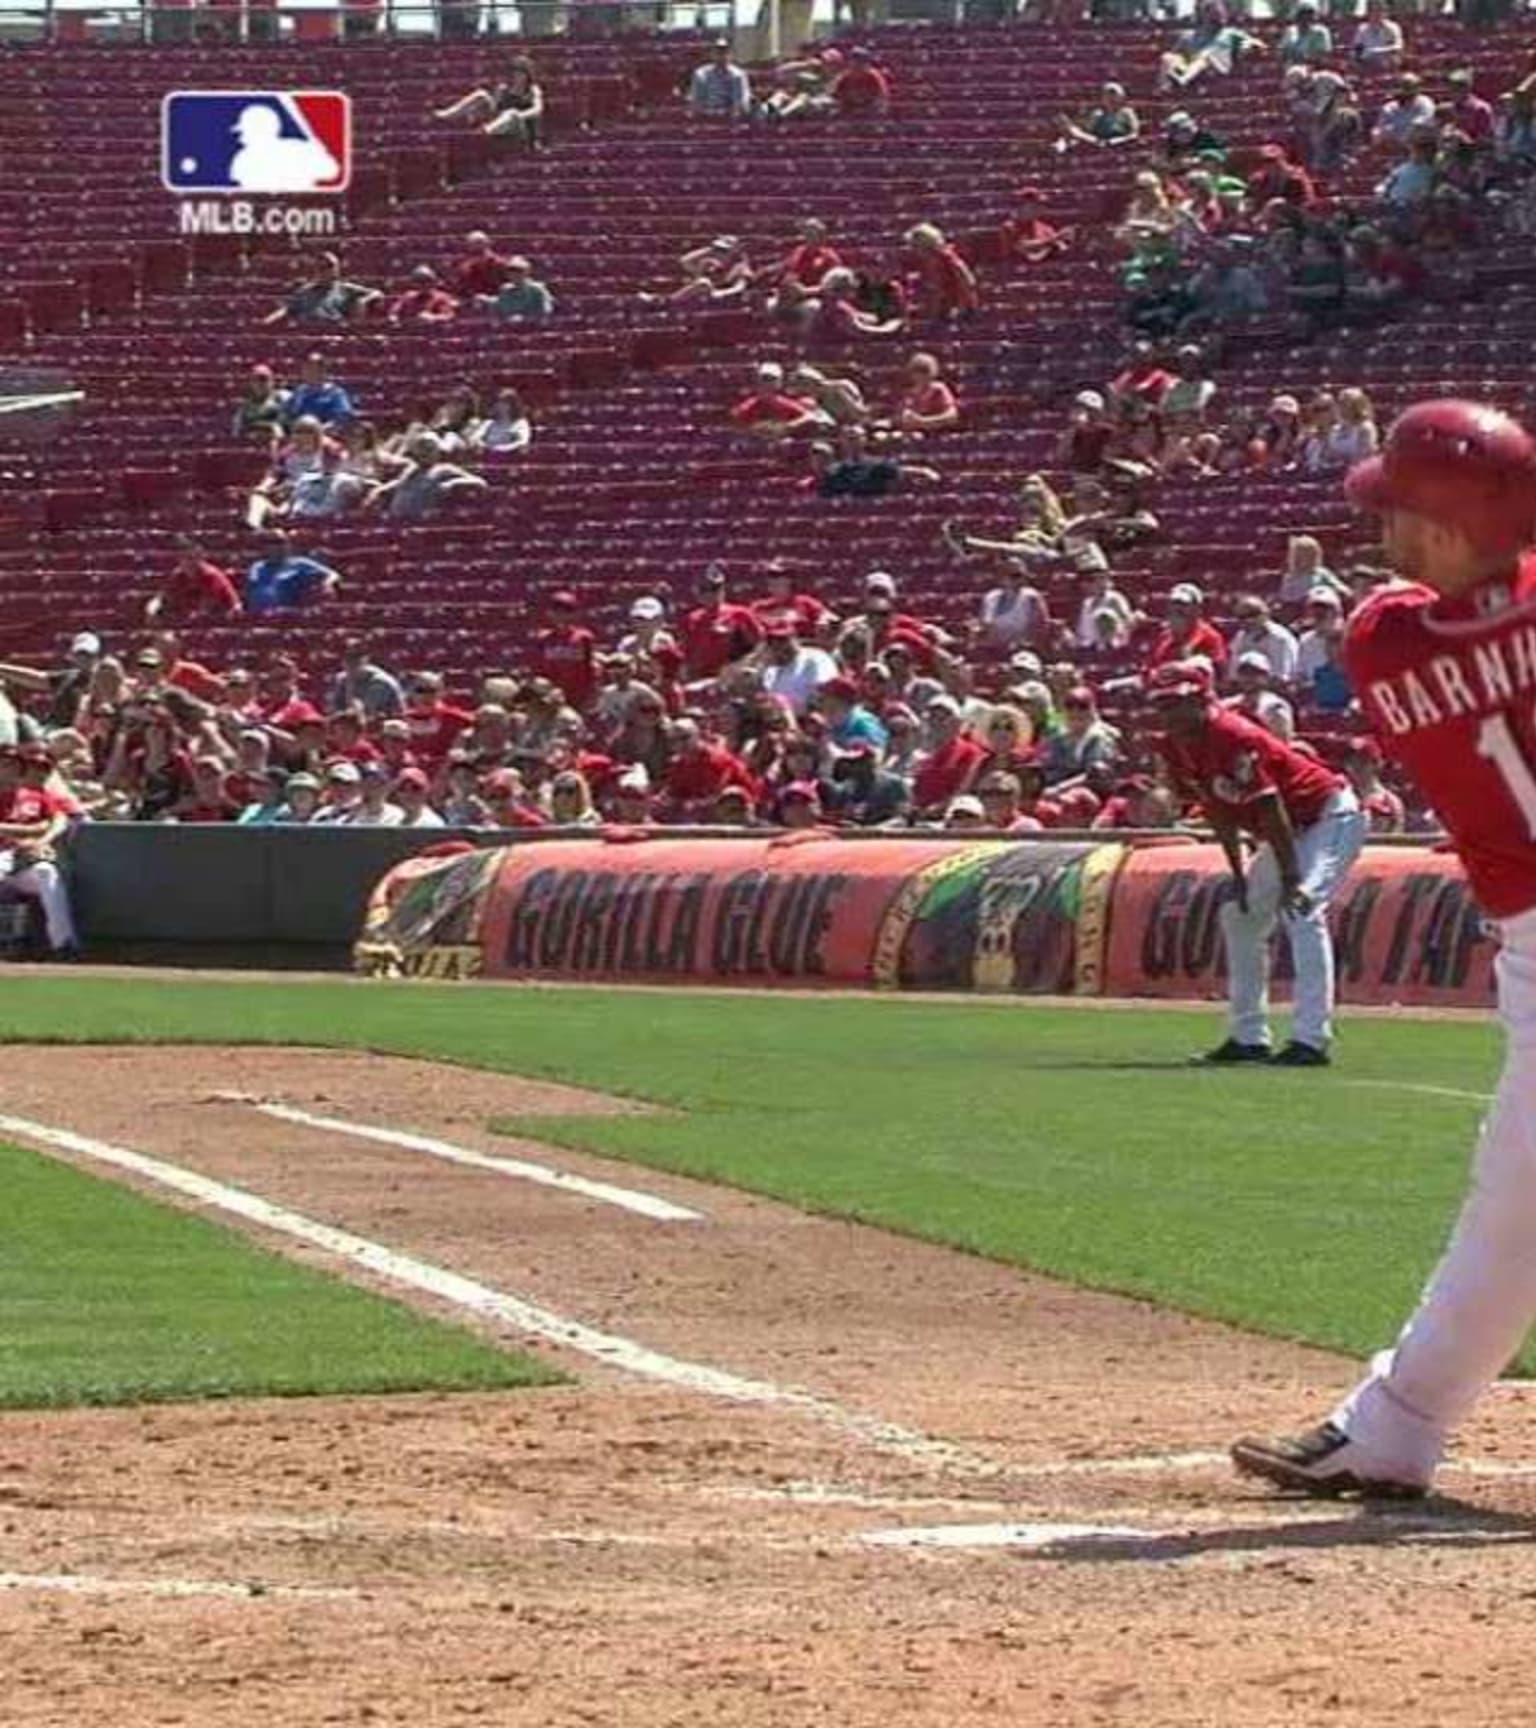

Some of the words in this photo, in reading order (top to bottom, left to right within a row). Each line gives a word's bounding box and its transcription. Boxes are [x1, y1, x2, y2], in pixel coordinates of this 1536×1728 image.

[506, 867, 710, 969] GORILLA
[713, 868, 848, 974] GLUE
[1380, 873, 1484, 988] TAP
